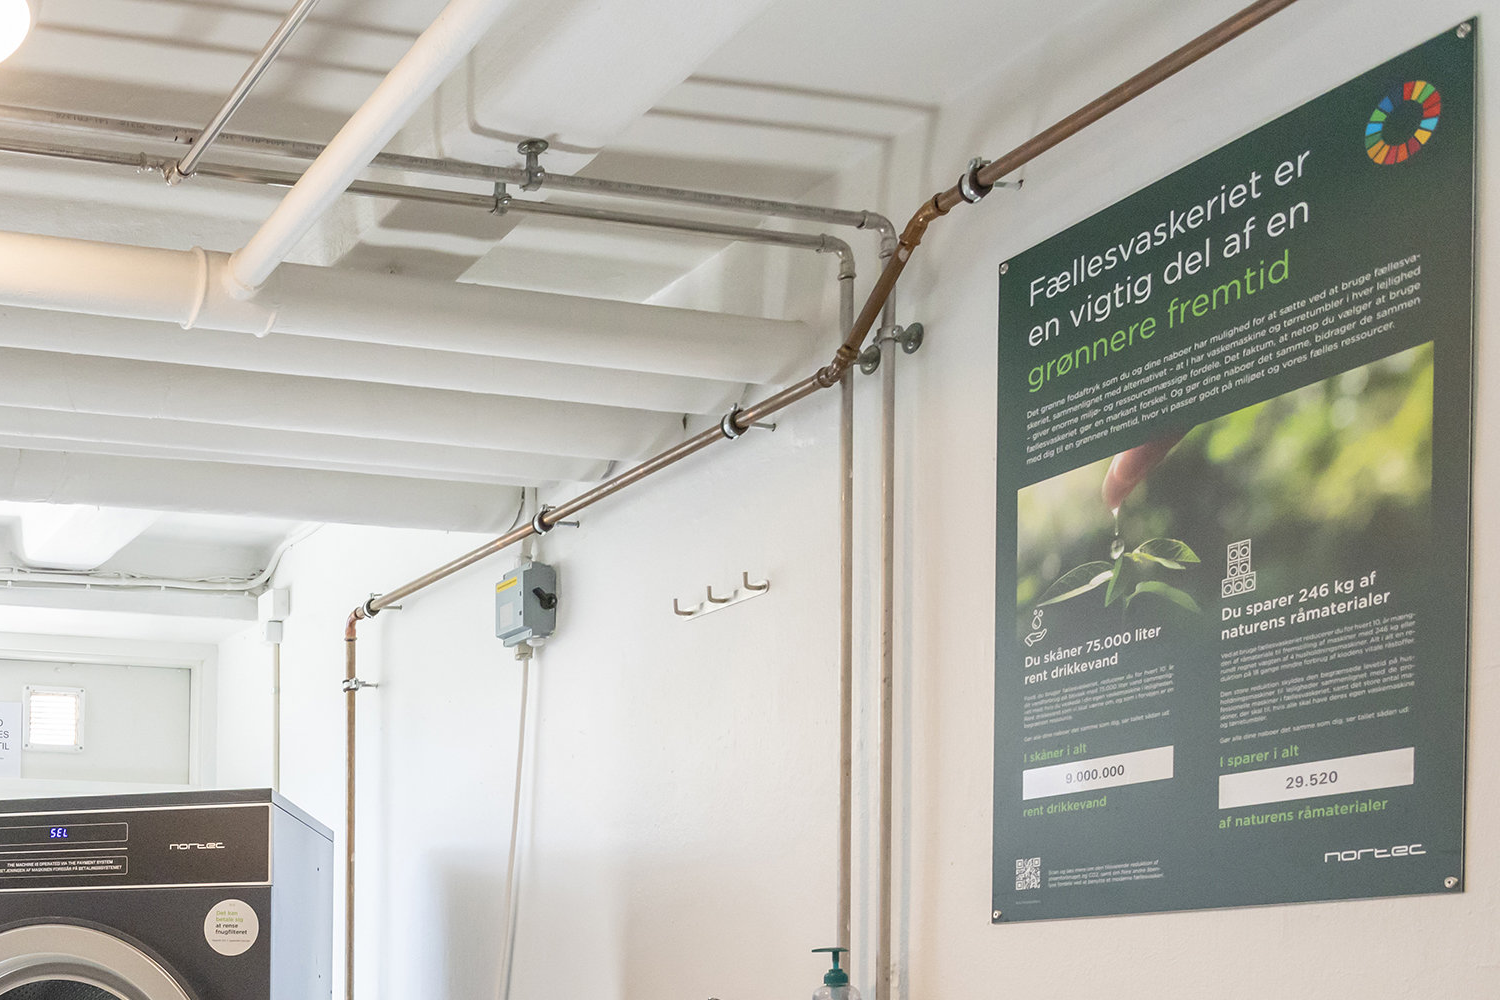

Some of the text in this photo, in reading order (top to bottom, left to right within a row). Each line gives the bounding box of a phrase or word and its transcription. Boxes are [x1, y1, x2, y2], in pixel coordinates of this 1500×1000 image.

[1029, 150, 1310, 307] Fællesvaskeriet er
[1028, 201, 1308, 346] en vigtig del af en
[1027, 248, 1288, 392] grønnere fremtid
[1026, 407, 1039, 419] Det
[1039, 397, 1065, 414] grønne
[1066, 383, 1100, 402] fodaftryk
[1101, 376, 1118, 388] som
[1119, 371, 1130, 381] du
[1131, 366, 1142, 376] og
[1143, 358, 1161, 371] dine
[1162, 345, 1192, 363] naboer
[1193, 339, 1208, 350] har
[1209, 320, 1250, 343] mulighed
[1252, 315, 1265, 326] for
[1267, 310, 1276, 320] at
[1278, 299, 1306, 316] sætte
[1308, 289, 1326, 303] ved
[1328, 284, 1338, 295] at
[1341, 272, 1371, 290] bruge
[1031, 427, 1050, 441] giver
[1050, 416, 1078, 432] enorme
[1102, 402, 1113, 411] og
[1115, 373, 1188, 407] ressourcemæssige
[1189, 360, 1221, 377] fordele.
[1223, 351, 1240, 364] Det
[1278, 332, 1288, 343] at
[1290, 321, 1319, 338] netop
[1321, 315, 1334, 326] du
[1337, 300, 1372, 319] vælger
[1375, 294, 1385, 305] at
[1388, 281, 1420, 300] bruge
[1052, 393, 1102, 420] sammenlignet
[1103, 385, 1121, 398] med
[1122, 367, 1167, 392] alternativet
[1175, 361, 1184, 370] at
[1190, 353, 1204, 364] har
[1206, 328, 1266, 357] vaskemaskine
[1268, 323, 1281, 333] og
[1282, 297, 1343, 327] tørretumbler
[1351, 285, 1374, 300] hver
[1376, 265, 1421, 290] lejlighed
[1078, 422, 1092, 434] gør
[1094, 418, 1104, 427] en
[1105, 404, 1137, 423] markant
[1169, 387, 1183, 398] Og
[1185, 380, 1200, 393] gør
[1202, 373, 1221, 385] dine
[1223, 359, 1255, 377] naboer
[1257, 352, 1272, 364] det
[1314, 320, 1356, 342] bidrager
[1359, 314, 1373, 325] de
[1376, 296, 1420, 319] sammen
[1025, 452, 1042, 464] med
[1042, 449, 1055, 459] dig
[1055, 444, 1063, 454] til
[1064, 442, 1074, 450] en
[1074, 429, 1108, 448] grønnere
[1141, 409, 1159, 421] hvor
[1160, 406, 1168, 414] vi
[1169, 395, 1197, 412] passer
[1198, 386, 1219, 401] godt
[1221, 379, 1232, 393] på
[1234, 368, 1265, 386] miljøet
[1266, 364, 1279, 374] og
[1281, 353, 1307, 368] vores
[1309, 341, 1338, 358] fælles
[1221, 570, 1376, 621] Du sparer 246 kg af
[1221, 591, 1390, 640] naturens råmaterialer
[1024, 626, 1161, 668] Du skåner 75.000 liter
[1024, 669, 1047, 685] rent
[1050, 651, 1118, 678] drikkevand
[1023, 742, 1087, 763] I skåner i alt
[1219, 744, 1299, 767] I sparer i alt
[1065, 764, 1125, 784] 9.000.000
[1285, 770, 1338, 789] 29.520
[1022, 795, 1106, 817] rent drikkevand
[1218, 798, 1388, 828] af naturens råmaterialer
[50, 827, 68, 838] SEL
[169, 842, 225, 851] nortec
[1324, 843, 1426, 862] nortec
